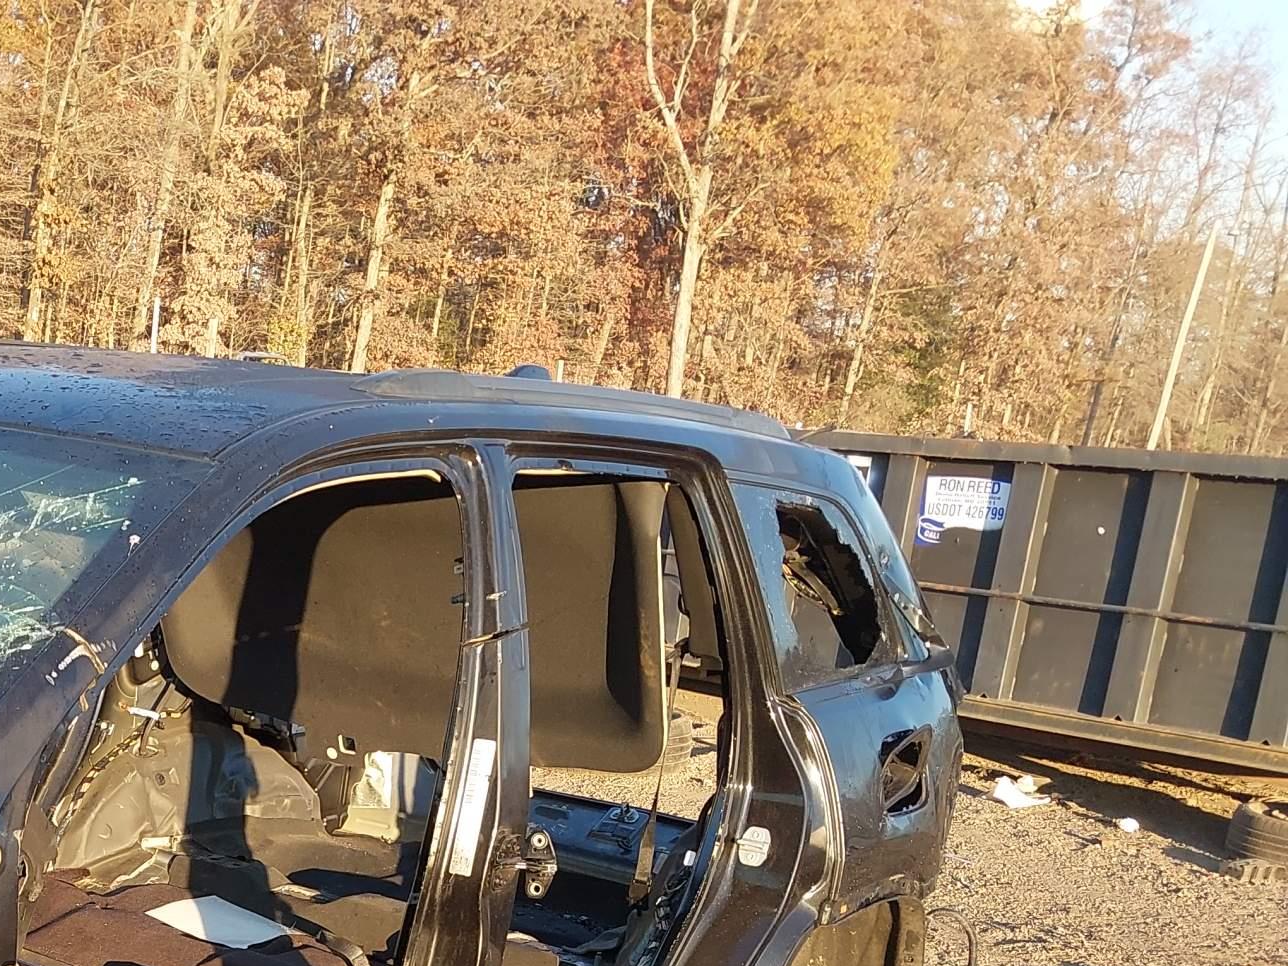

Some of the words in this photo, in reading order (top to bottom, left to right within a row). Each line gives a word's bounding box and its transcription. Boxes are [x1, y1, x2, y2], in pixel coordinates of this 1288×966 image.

[939, 479, 965, 492] RON
[967, 481, 1001, 494] REED
[928, 502, 962, 516] USDOT
[965, 505, 1005, 521] 426799
